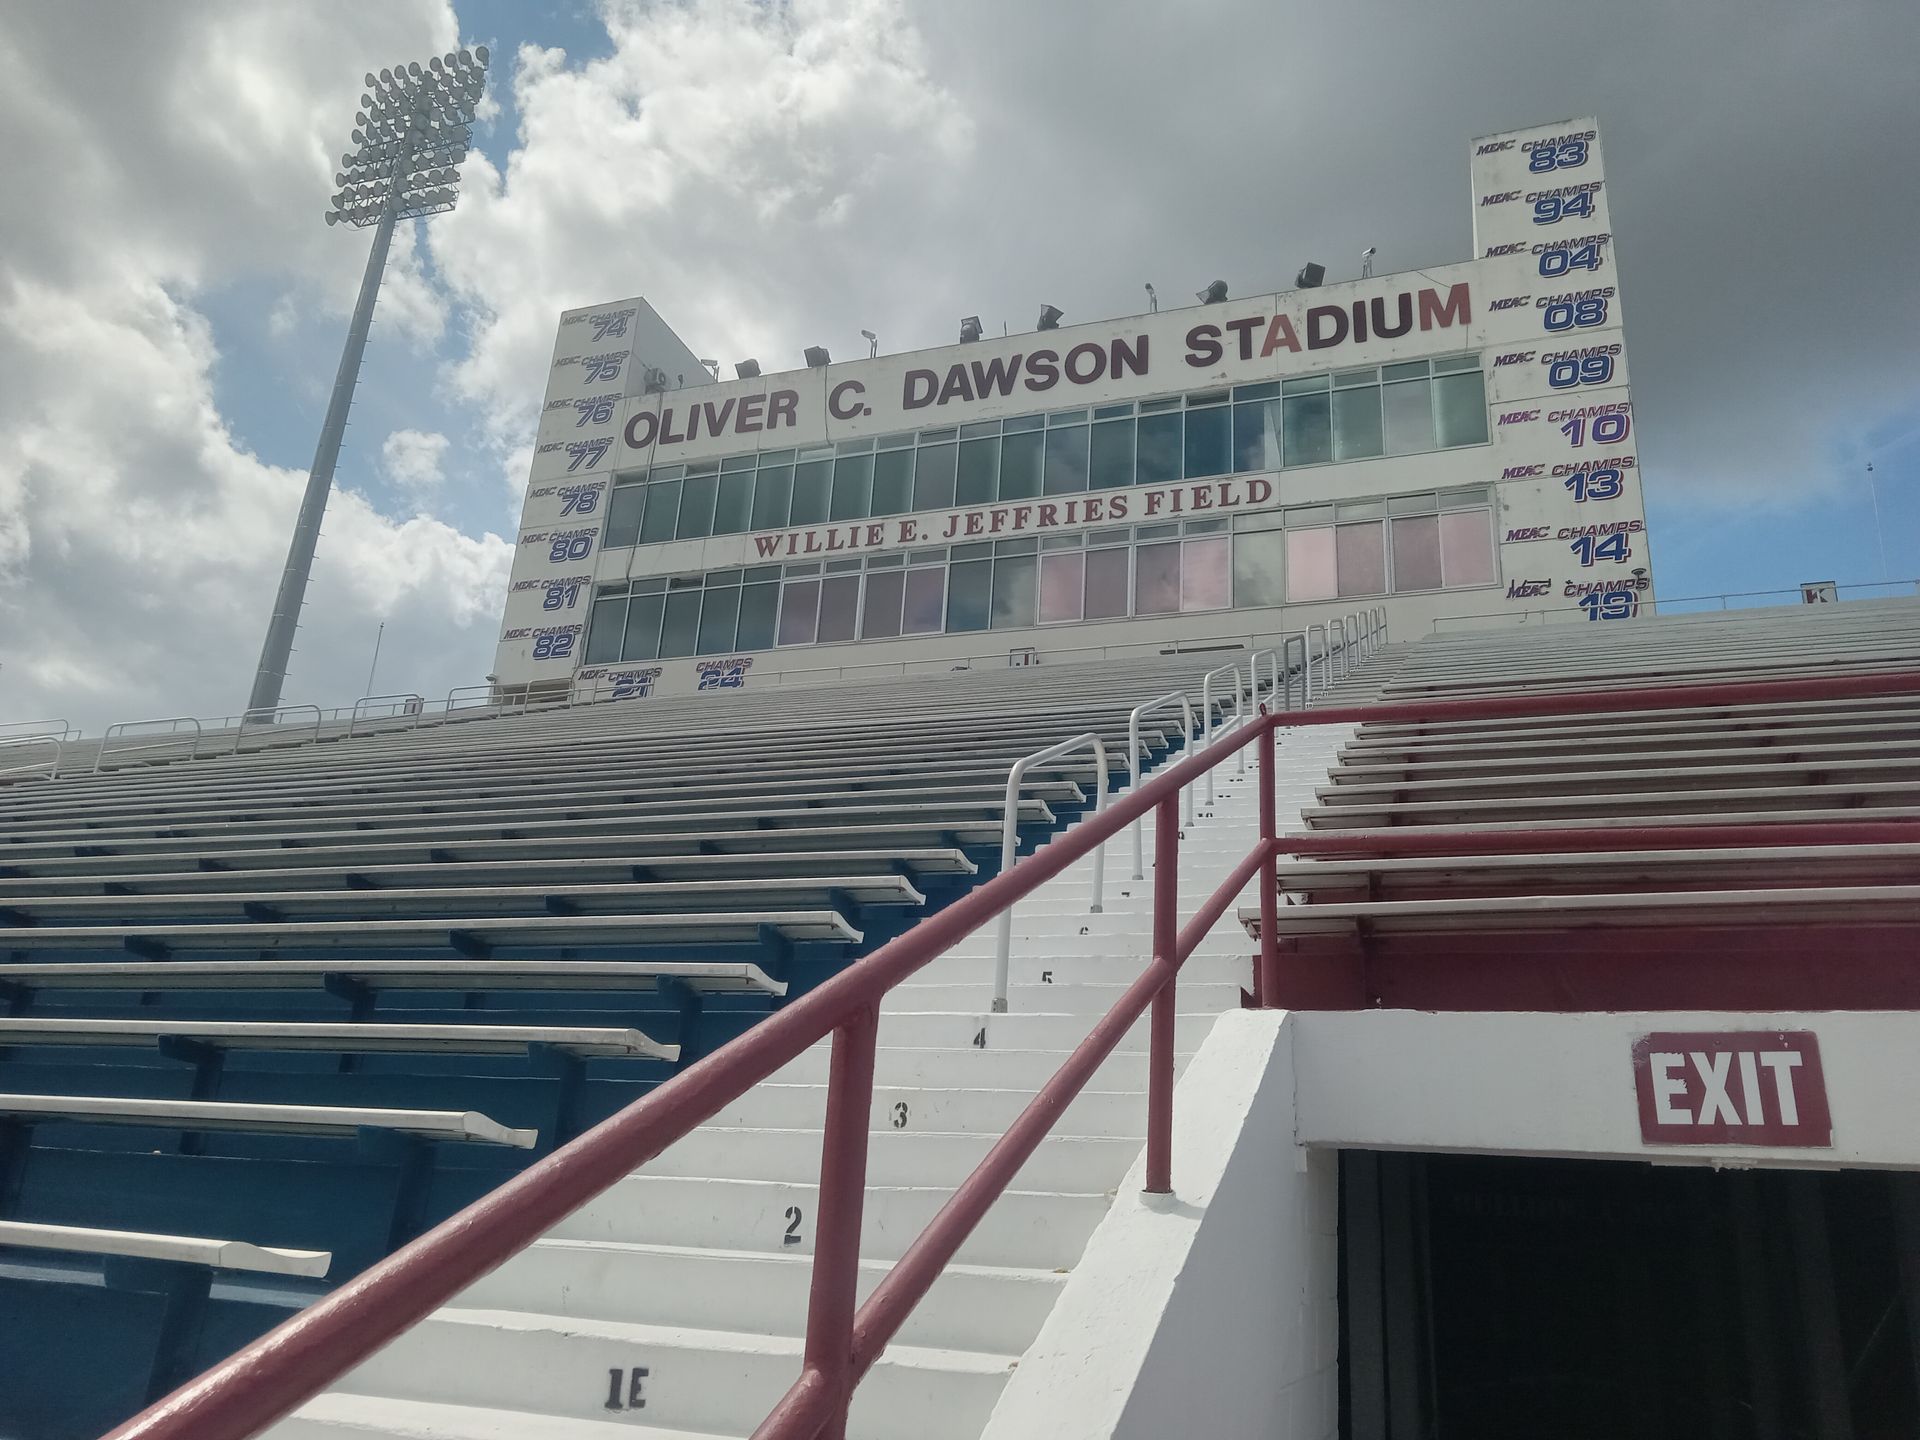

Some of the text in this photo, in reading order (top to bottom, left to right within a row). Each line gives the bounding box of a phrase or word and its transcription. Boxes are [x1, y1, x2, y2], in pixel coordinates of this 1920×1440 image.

[1521, 130, 1597, 152] CHAMPS
[1528, 141, 1590, 174] 83
[1525, 182, 1602, 203] CHAMPS
[1533, 192, 1596, 225] 94
[1531, 233, 1609, 255] CHAMPS
[1538, 245, 1602, 278] 04
[1536, 287, 1615, 309] CHAMPS
[589, 308, 637, 325] CHAMPS
[1544, 298, 1608, 332] 08
[592, 316, 628, 342] 74
[581, 351, 630, 367] CHAMPS
[624, 283, 1471, 449] OLIVER C. DAWSON STADIUM
[1540, 344, 1622, 364] CHAMPS
[584, 358, 622, 384] 75
[1548, 355, 1614, 389] 09
[573, 393, 622, 408] CHAMPS
[1548, 402, 1630, 424] CHAMPS
[576, 400, 616, 428] 76
[1560, 414, 1631, 448] 10
[565, 437, 614, 452] CHAMPS
[567, 444, 608, 472] 77
[1552, 456, 1636, 477] CHAMPS
[557, 482, 606, 496] CHAMPS
[1564, 469, 1624, 502] 13
[560, 491, 599, 516] 78
[754, 479, 1272, 559] WILLIE E. JEFFRIES FIELD
[1557, 520, 1644, 540] CHAMPS
[548, 527, 600, 542] CHAMPS
[549, 535, 594, 563] 80
[1570, 533, 1632, 567] 14
[540, 576, 592, 590] CHAMPS
[1564, 578, 1650, 598] CHAMPS
[543, 584, 580, 611] 81
[1578, 590, 1638, 622] 19
[532, 624, 582, 638] CHAMPS
[532, 632, 576, 660] 82
[608, 667, 663, 682] CHAMPS
[696, 658, 753, 673] CHAMPS
[612, 676, 652, 698] 21
[698, 668, 744, 691] 24
[973, 1027, 986, 1049] 4
[1650, 1051, 1803, 1125] EXIT
[893, 1102, 908, 1128] 3
[784, 1206, 802, 1246] 2
[604, 1367, 650, 1411] 1E
